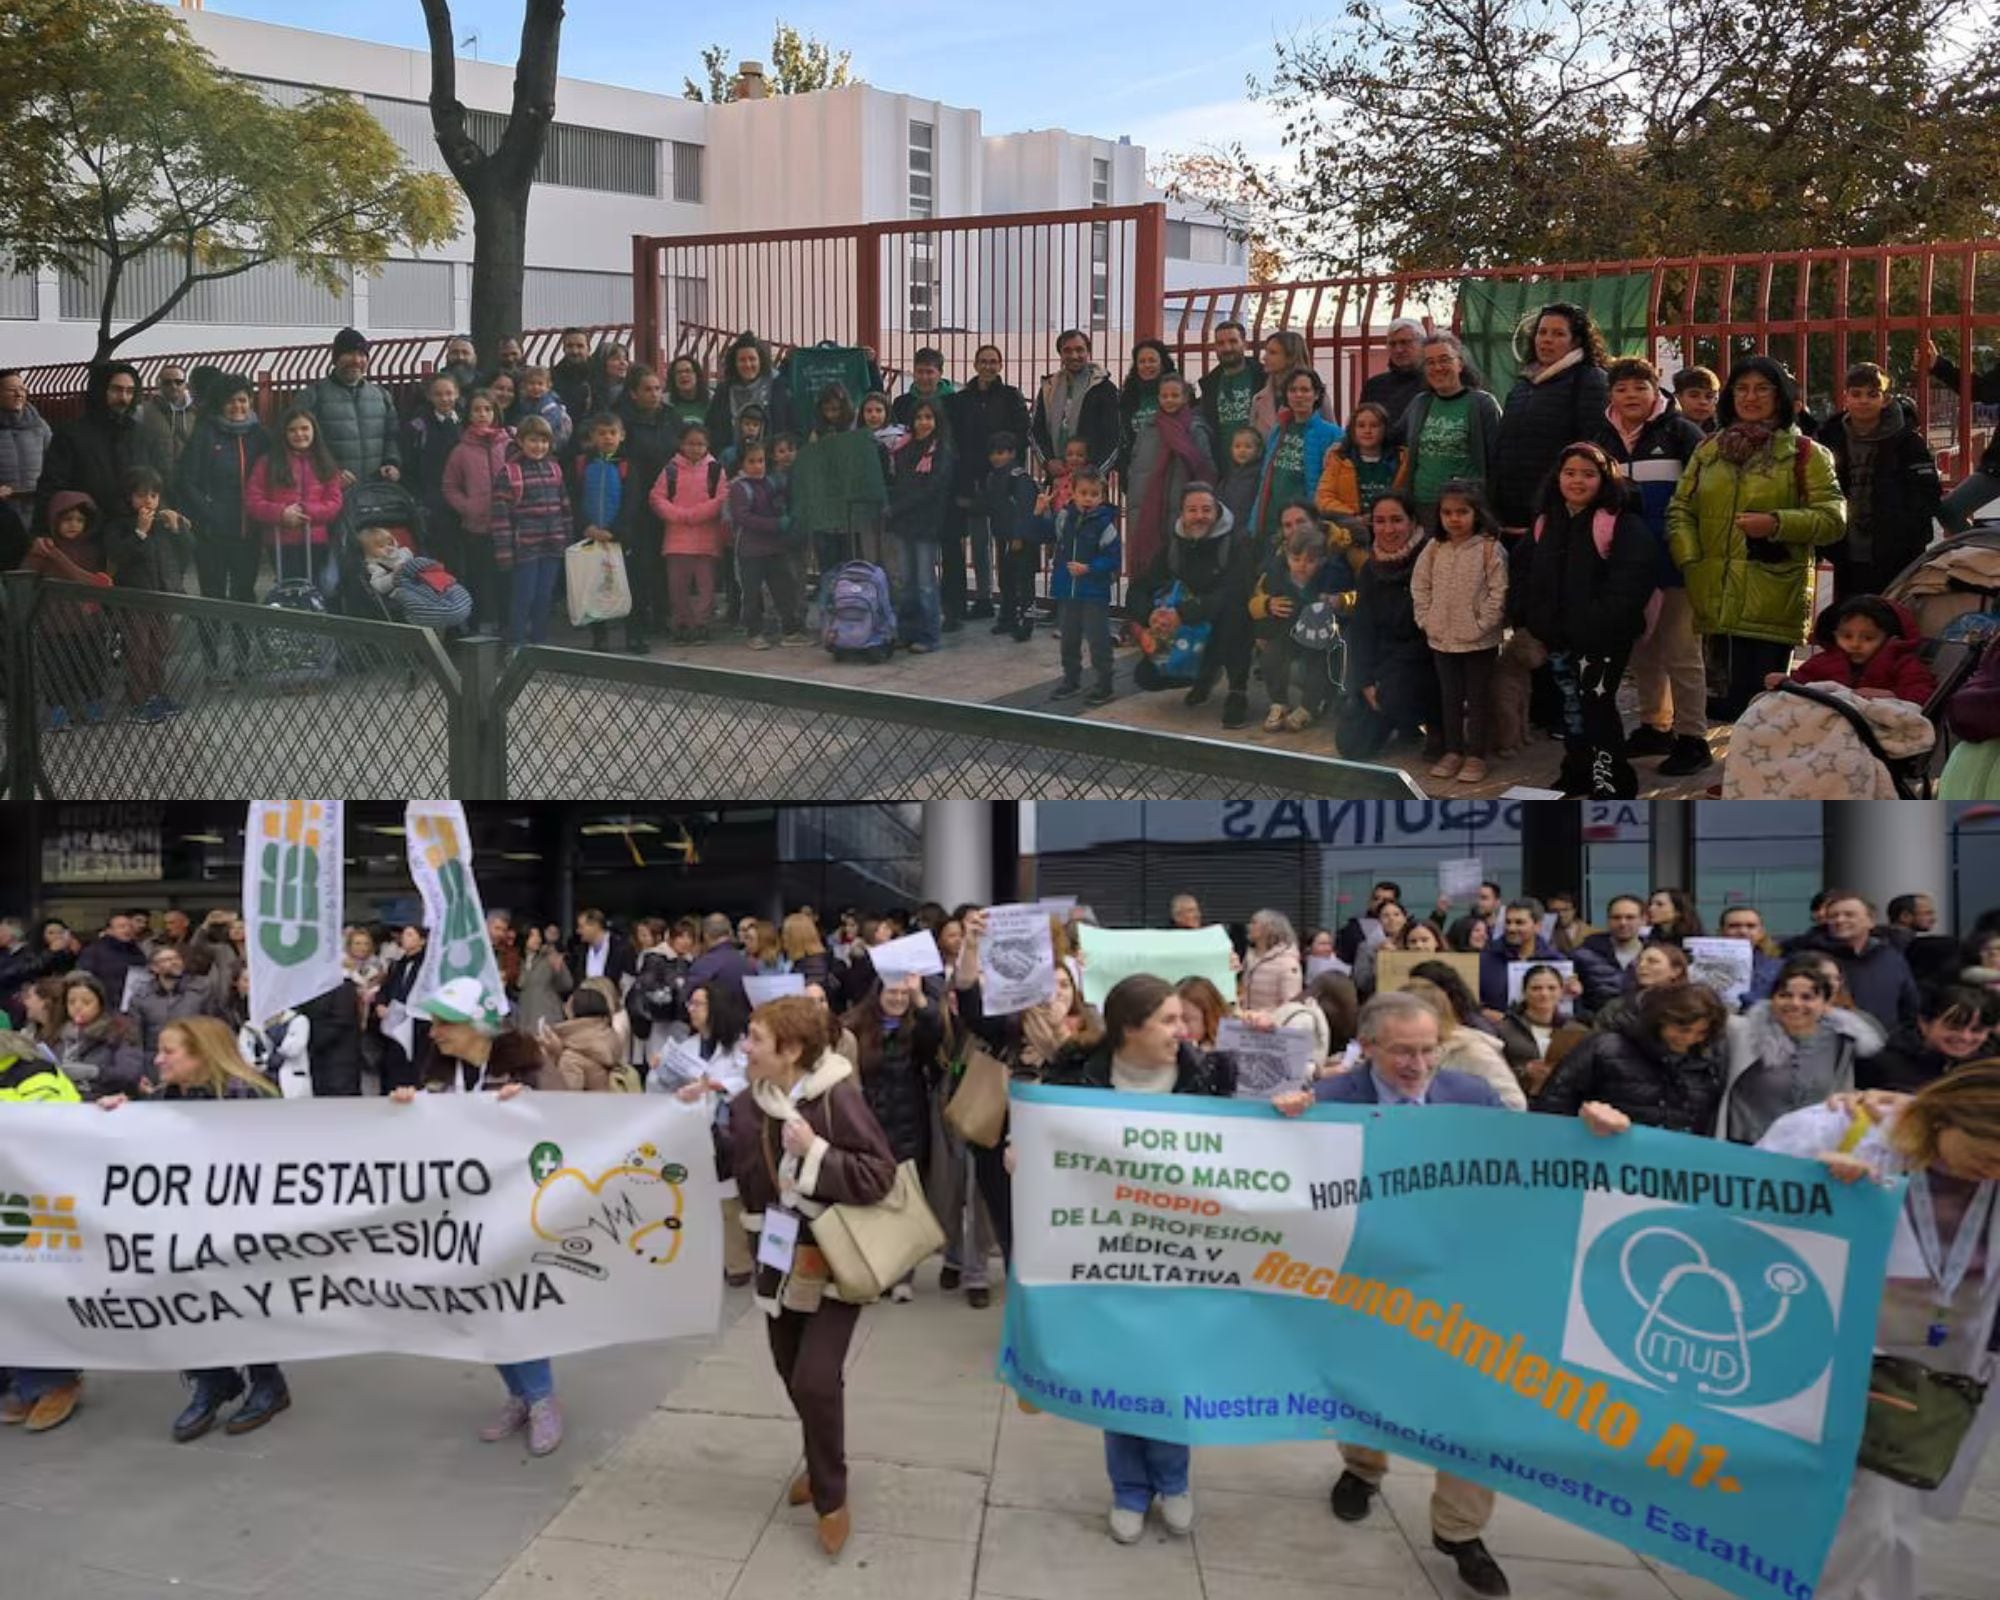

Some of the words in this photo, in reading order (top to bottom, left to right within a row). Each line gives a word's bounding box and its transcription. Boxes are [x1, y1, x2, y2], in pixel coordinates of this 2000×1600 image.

[1122, 1126, 1178, 1151] POR
[1186, 1130, 1223, 1153] UN
[102, 1164, 191, 1206] POR
[205, 1163, 260, 1206] UN
[273, 1158, 492, 1206] ESTATUTO
[1053, 1151, 1185, 1186] ESTATUTO
[1192, 1166, 1290, 1192] MARCO
[1309, 1176, 1373, 1211] HORA
[1619, 1164, 1834, 1217] COMPUTADA
[1114, 1185, 1221, 1217] PROPIO
[105, 1233, 155, 1274] DE
[169, 1233, 229, 1273] LA
[234, 1210, 482, 1268] PROFESIÓN
[1051, 1208, 1084, 1227] DE
[1091, 1207, 1123, 1226] LA
[1130, 1212, 1284, 1246] PROFESIÓN
[1098, 1232, 1197, 1261] MÉDICA
[1205, 1247, 1224, 1262] Y
[1071, 1262, 1241, 1286] FACULTATIVA
[66, 1286, 246, 1330] MÉDICA
[243, 1277, 275, 1319] Y
[289, 1271, 565, 1316] FACULTATIVA
[1251, 1249, 1641, 1451] Reconocimiento
[1003, 1346, 1082, 1405] Nestra
[1184, 1393, 1279, 1420] Nuestra
[1489, 1452, 1633, 1519] Nuestro
